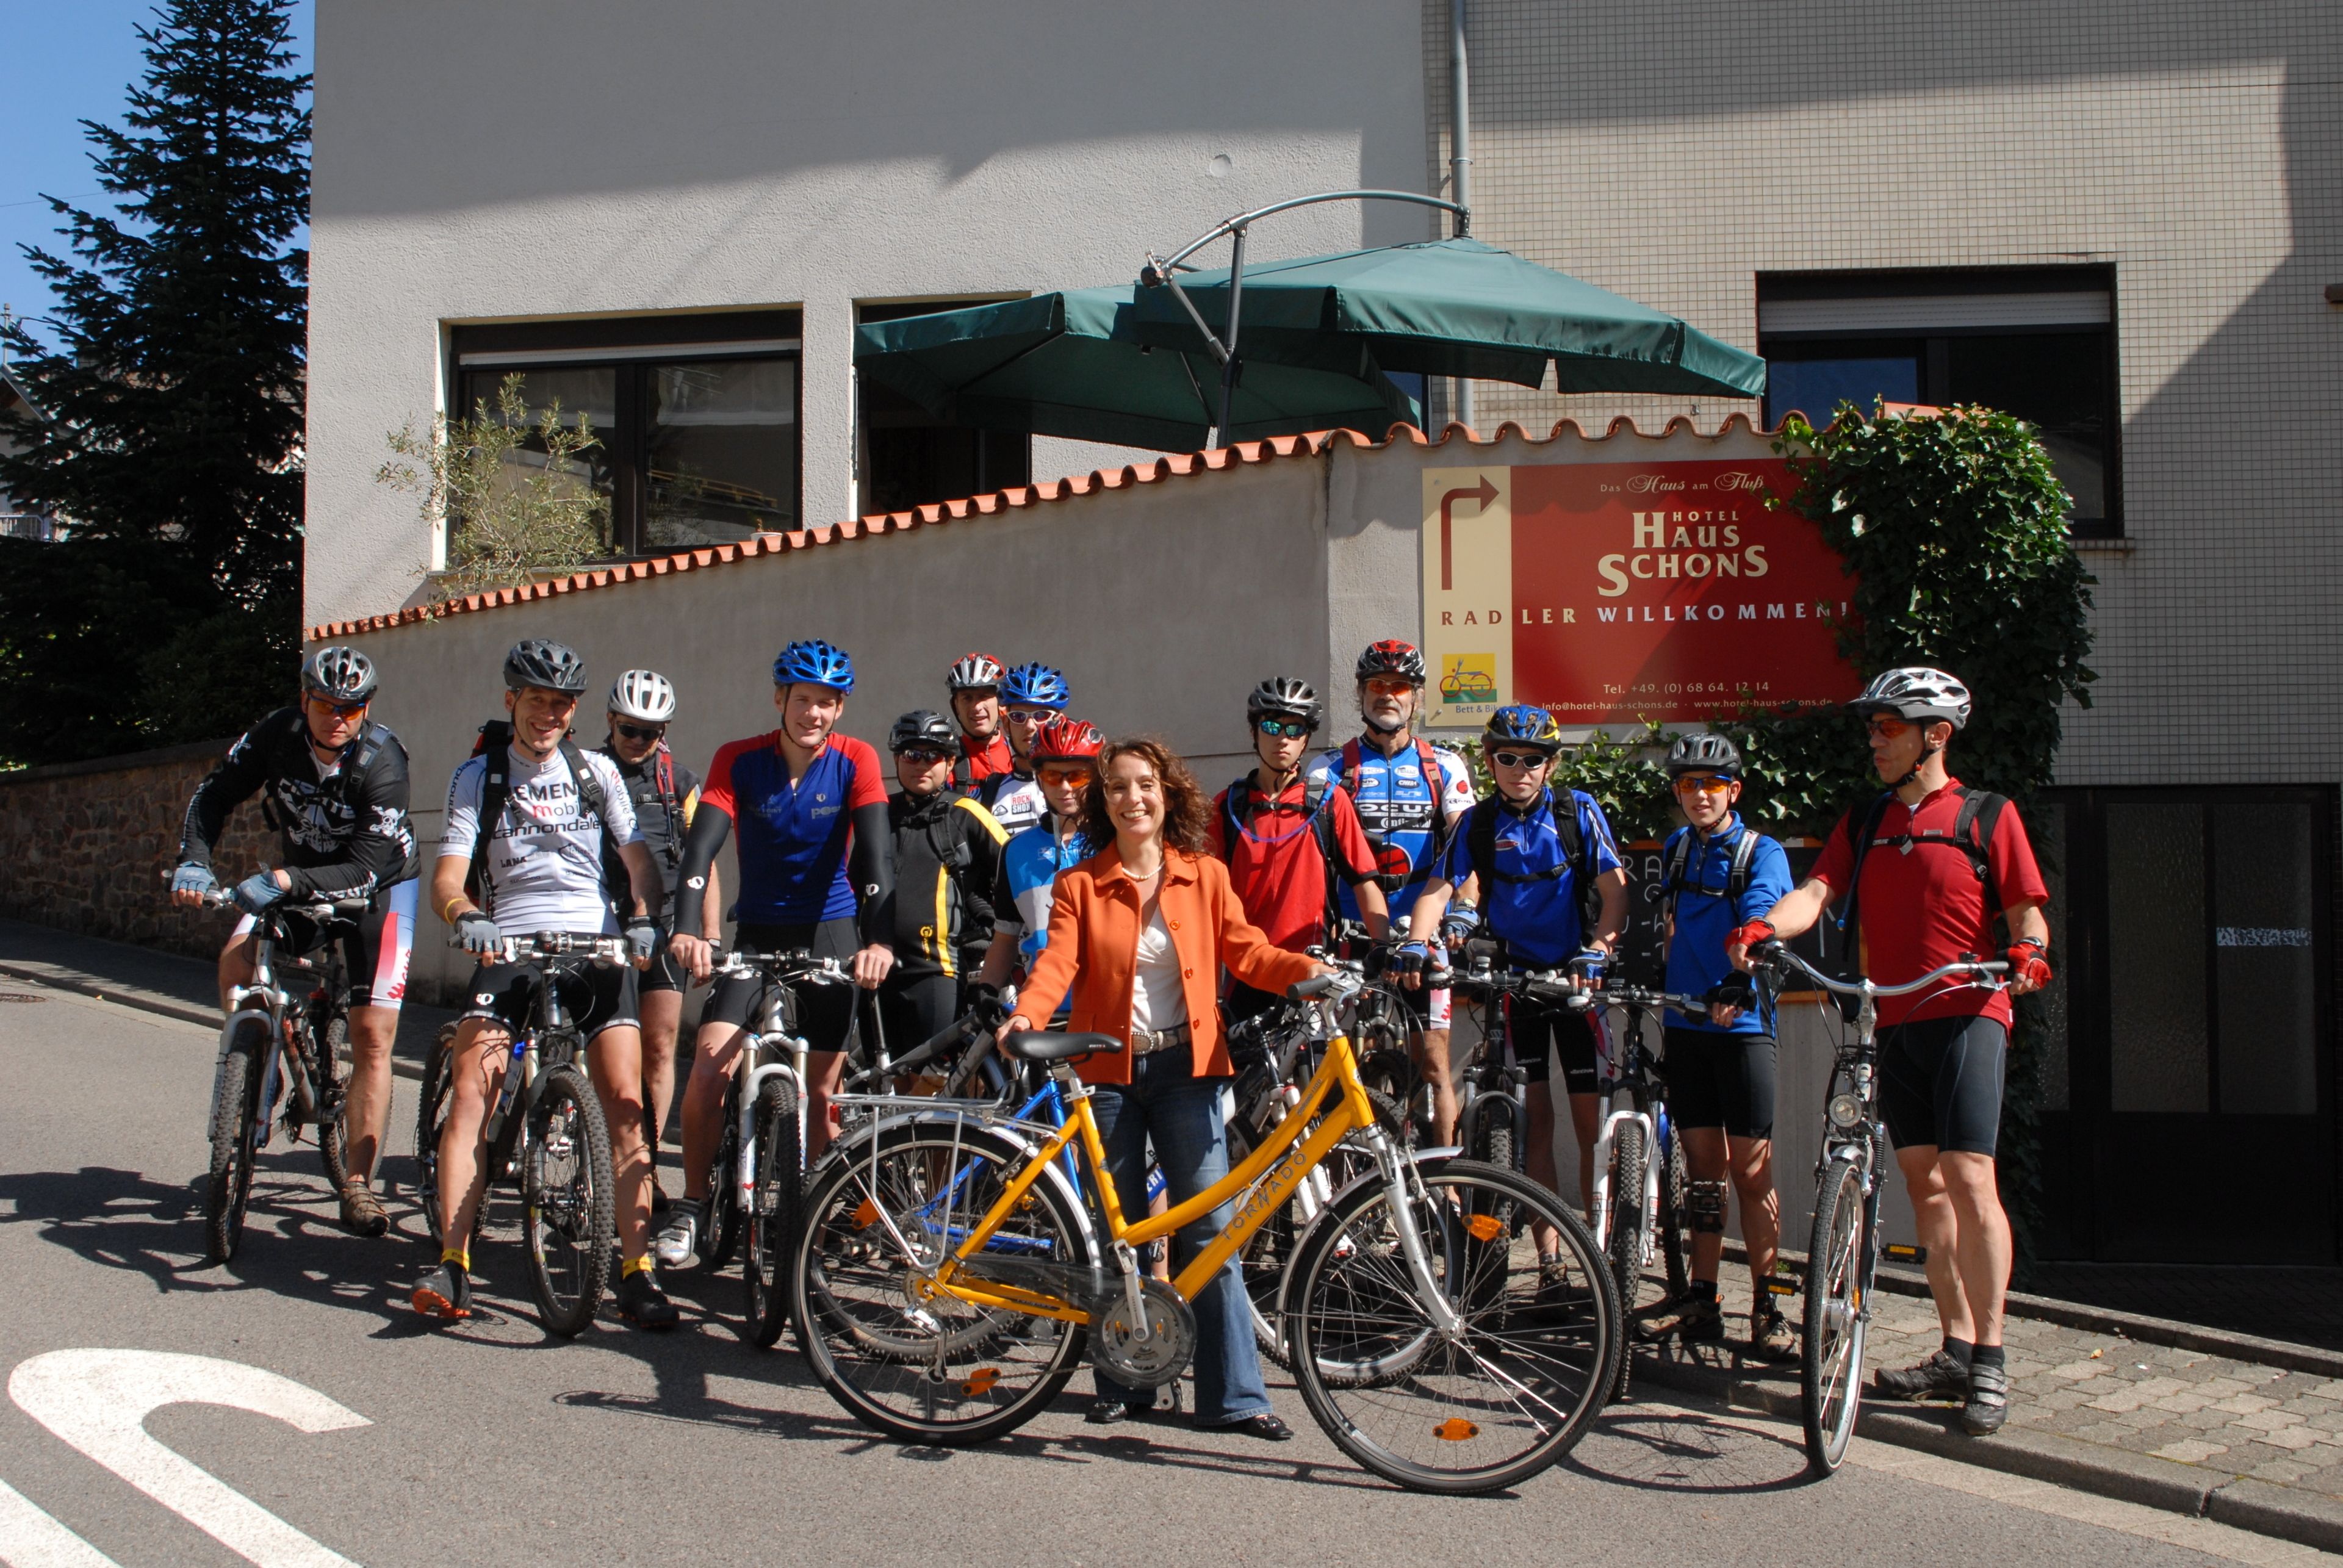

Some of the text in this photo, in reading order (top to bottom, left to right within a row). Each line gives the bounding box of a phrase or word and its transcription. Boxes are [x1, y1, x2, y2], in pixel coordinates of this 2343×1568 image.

[1627, 474, 1685, 493] Haus
[1715, 472, 1764, 492] Fluß
[1672, 511, 1739, 522] HOTEL
[1632, 512, 1740, 548] HAUS
[1597, 545, 1768, 597] SCHONS
[1441, 608, 1576, 625] RADLER
[1603, 682, 1769, 694] Tel. +49. (0) 68 64. 12 14
[1542, 700, 1678, 711] info@hotel-haus-schons.de
[448, 758, 478, 826] cannondale
[514, 782, 578, 802] EMEN
[611, 771, 631, 815] mobile
[1012, 794, 1031, 804] ROCK
[1358, 804, 1433, 815] OCUS
[492, 819, 602, 840] cannondale
[1222, 1153, 1307, 1240] TORNADO
